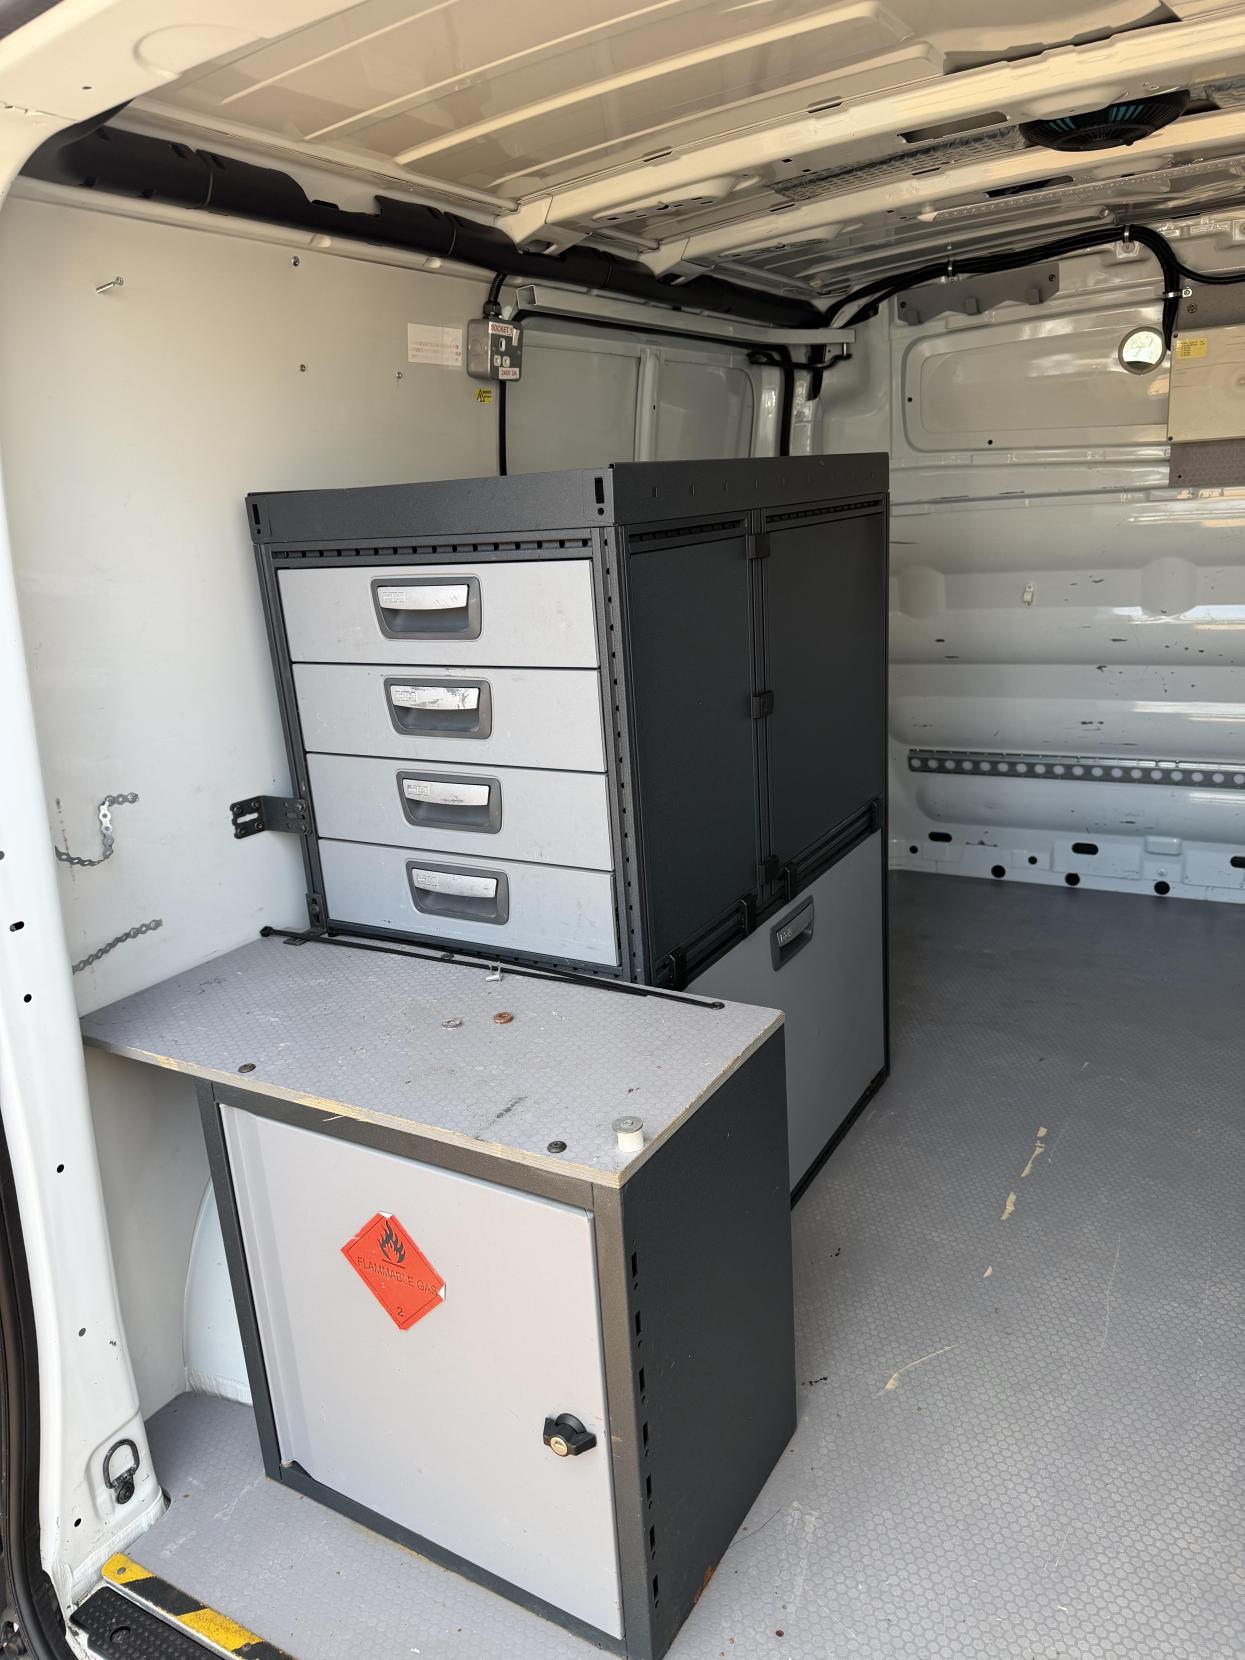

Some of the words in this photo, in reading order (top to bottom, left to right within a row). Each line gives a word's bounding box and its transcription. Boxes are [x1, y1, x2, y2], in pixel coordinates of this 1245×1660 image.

[491, 324, 509, 334] SOCKET
[357, 1256, 415, 1288] FLAMMABLE
[416, 1280, 437, 1296] GAS
[396, 1306, 404, 1317] 2
